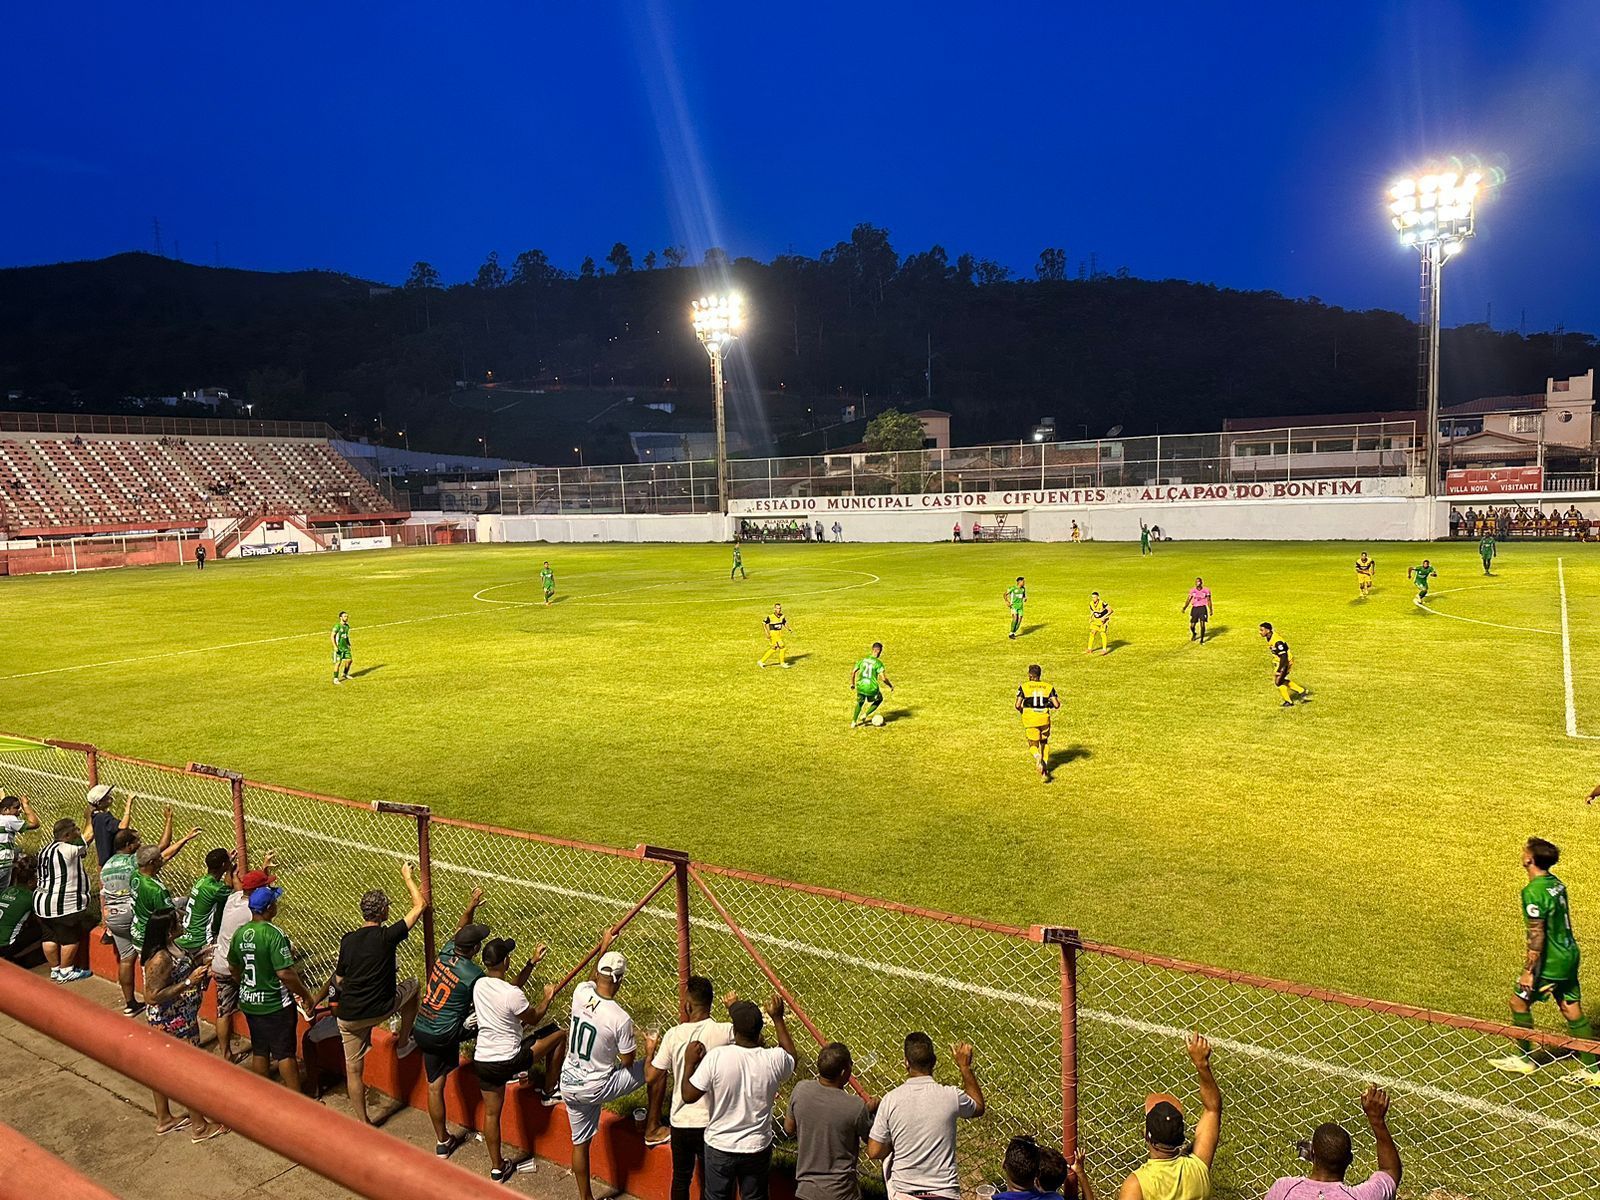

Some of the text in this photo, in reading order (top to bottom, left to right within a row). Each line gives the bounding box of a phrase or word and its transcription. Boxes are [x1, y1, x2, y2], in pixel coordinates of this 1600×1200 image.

[1236, 484, 1264, 498] DO
[1273, 480, 1363, 497] BONFIM
[827, 497, 913, 509] MUNICIPAL
[923, 494, 987, 506] CASTOR
[1003, 489, 1106, 504] CIFUENTES
[862, 662, 873, 679] 21
[1033, 690, 1044, 707] 11
[243, 954, 256, 987] 5
[570, 1015, 597, 1061] 10
